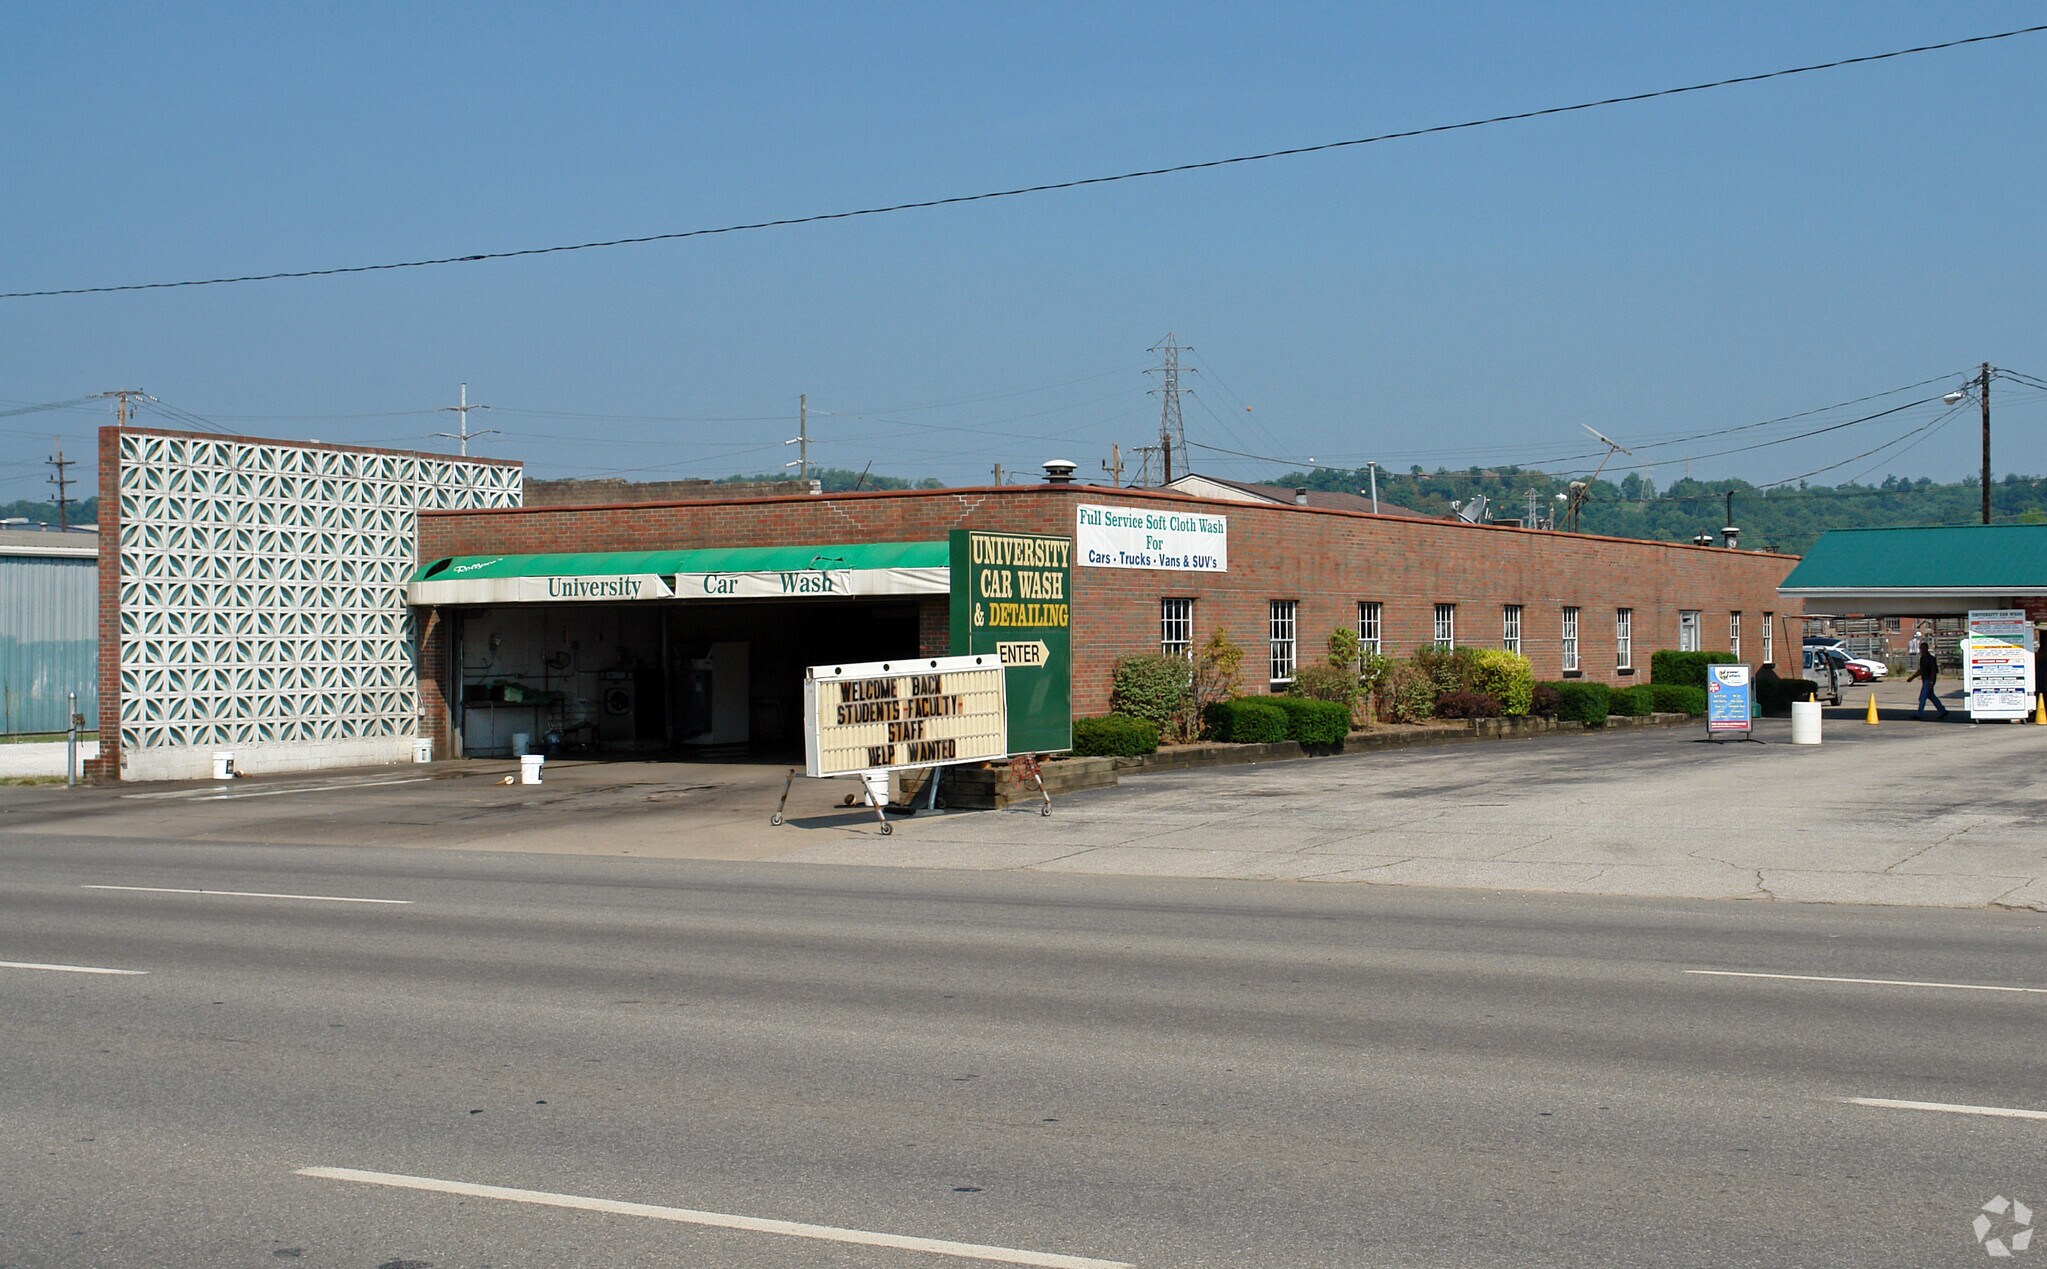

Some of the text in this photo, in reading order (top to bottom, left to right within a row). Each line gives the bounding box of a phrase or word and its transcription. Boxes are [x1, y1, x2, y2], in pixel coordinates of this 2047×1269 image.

[1079, 509, 1224, 534] Full Service Soft Cloth Wash
[971, 535, 1070, 568] UNIVERSITY
[1146, 535, 1163, 550] For
[1089, 550, 1217, 568] Cars Trucks Vans & SUV's
[548, 571, 833, 600] University Car Wash
[980, 569, 1063, 599] CAR WASH
[974, 602, 1069, 627] & DETAILING
[1000, 644, 1040, 663] ENTER
[841, 675, 942, 702] WELCOME BACK
[837, 700, 900, 725] STUDENTS
[888, 720, 924, 743] STAFF
[868, 739, 956, 767] HELP WANTED
